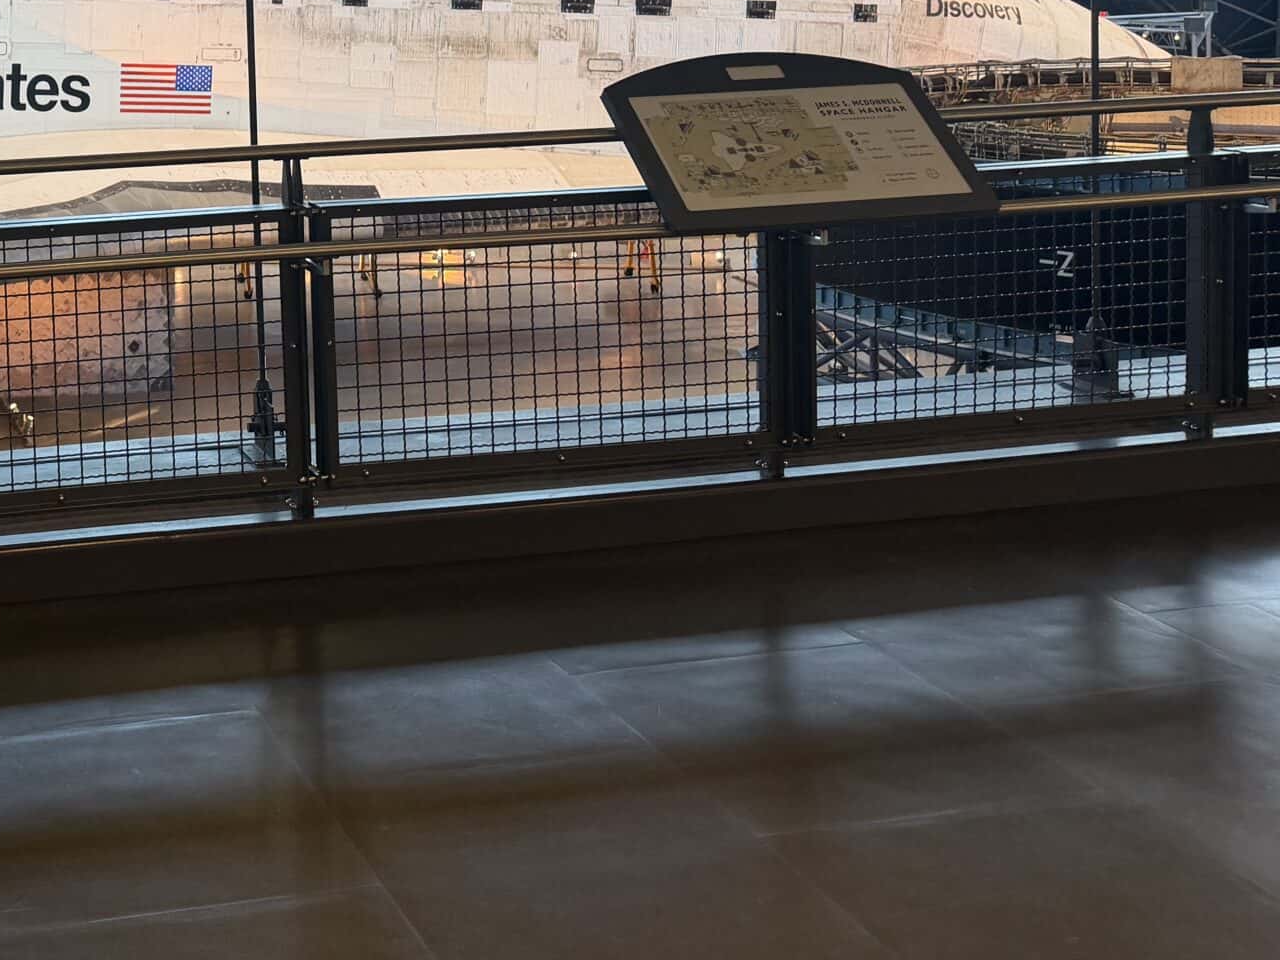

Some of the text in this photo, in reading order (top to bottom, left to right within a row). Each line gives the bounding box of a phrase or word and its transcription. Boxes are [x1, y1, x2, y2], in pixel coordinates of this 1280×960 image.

[815, 101, 840, 110] JAMES
[820, 105, 907, 116] SPACE HANGAR
